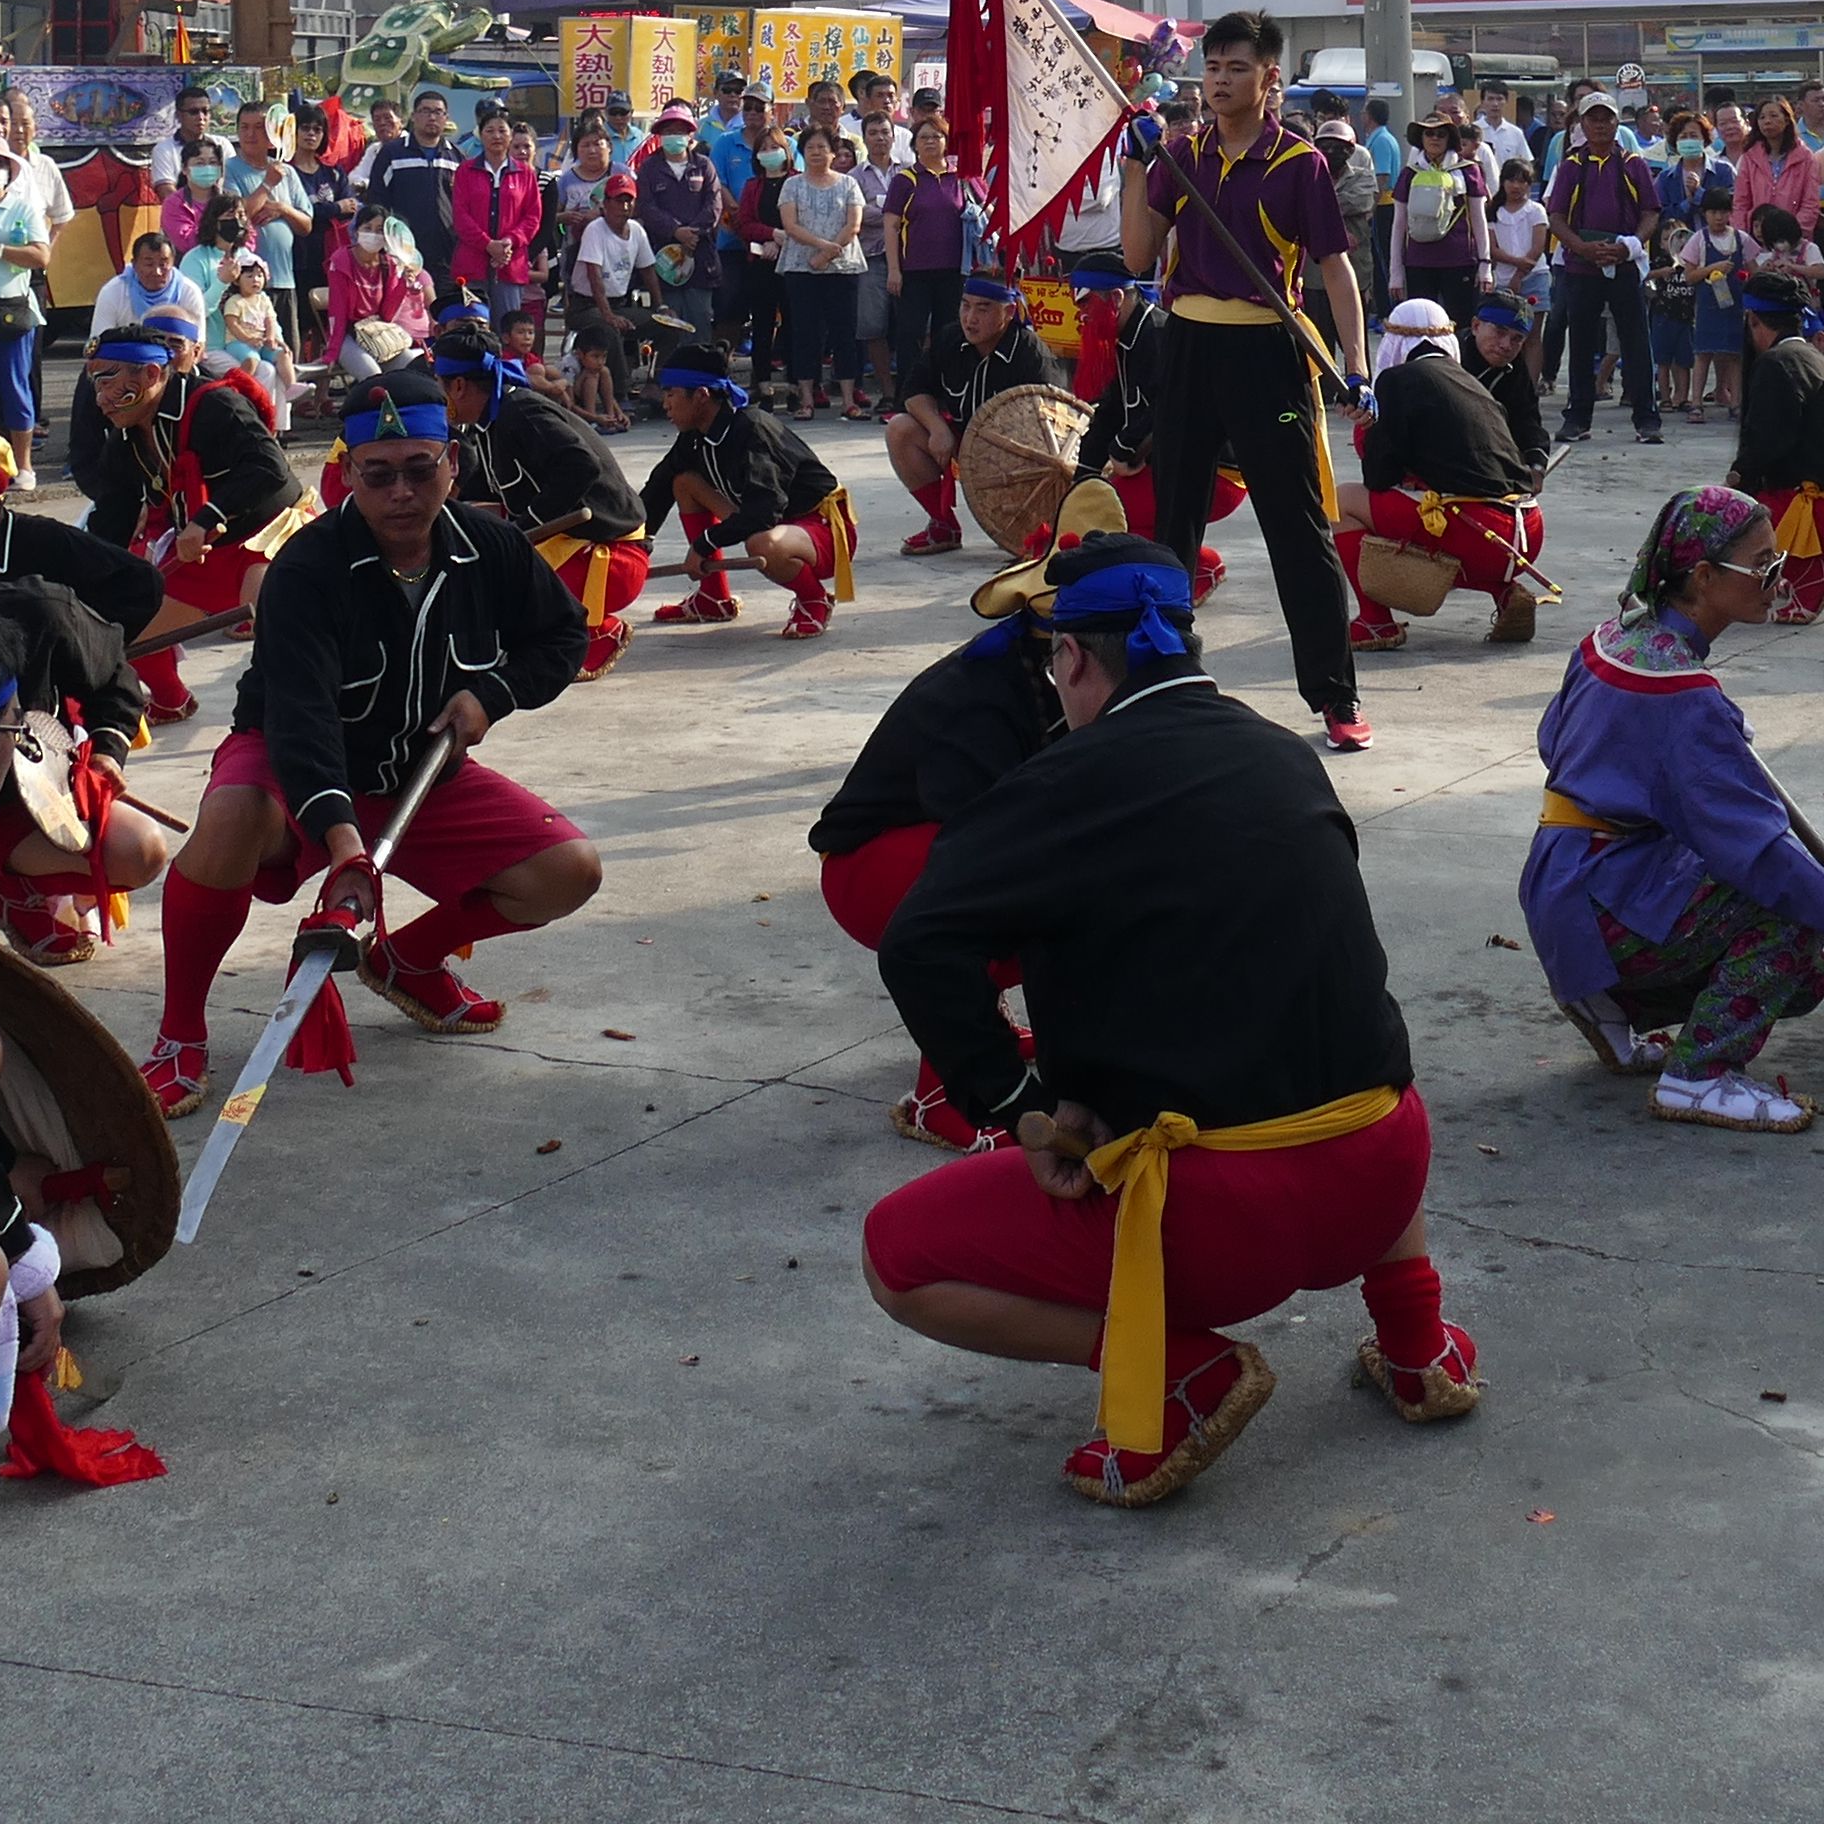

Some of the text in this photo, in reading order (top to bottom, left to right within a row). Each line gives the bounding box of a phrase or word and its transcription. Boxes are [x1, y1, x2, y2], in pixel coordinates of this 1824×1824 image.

[575, 23, 614, 110] 大熱狗
[649, 26, 677, 110] 大熱狗
[781, 23, 802, 93] 冬瓜茶
[852, 27, 869, 71] 仙草
